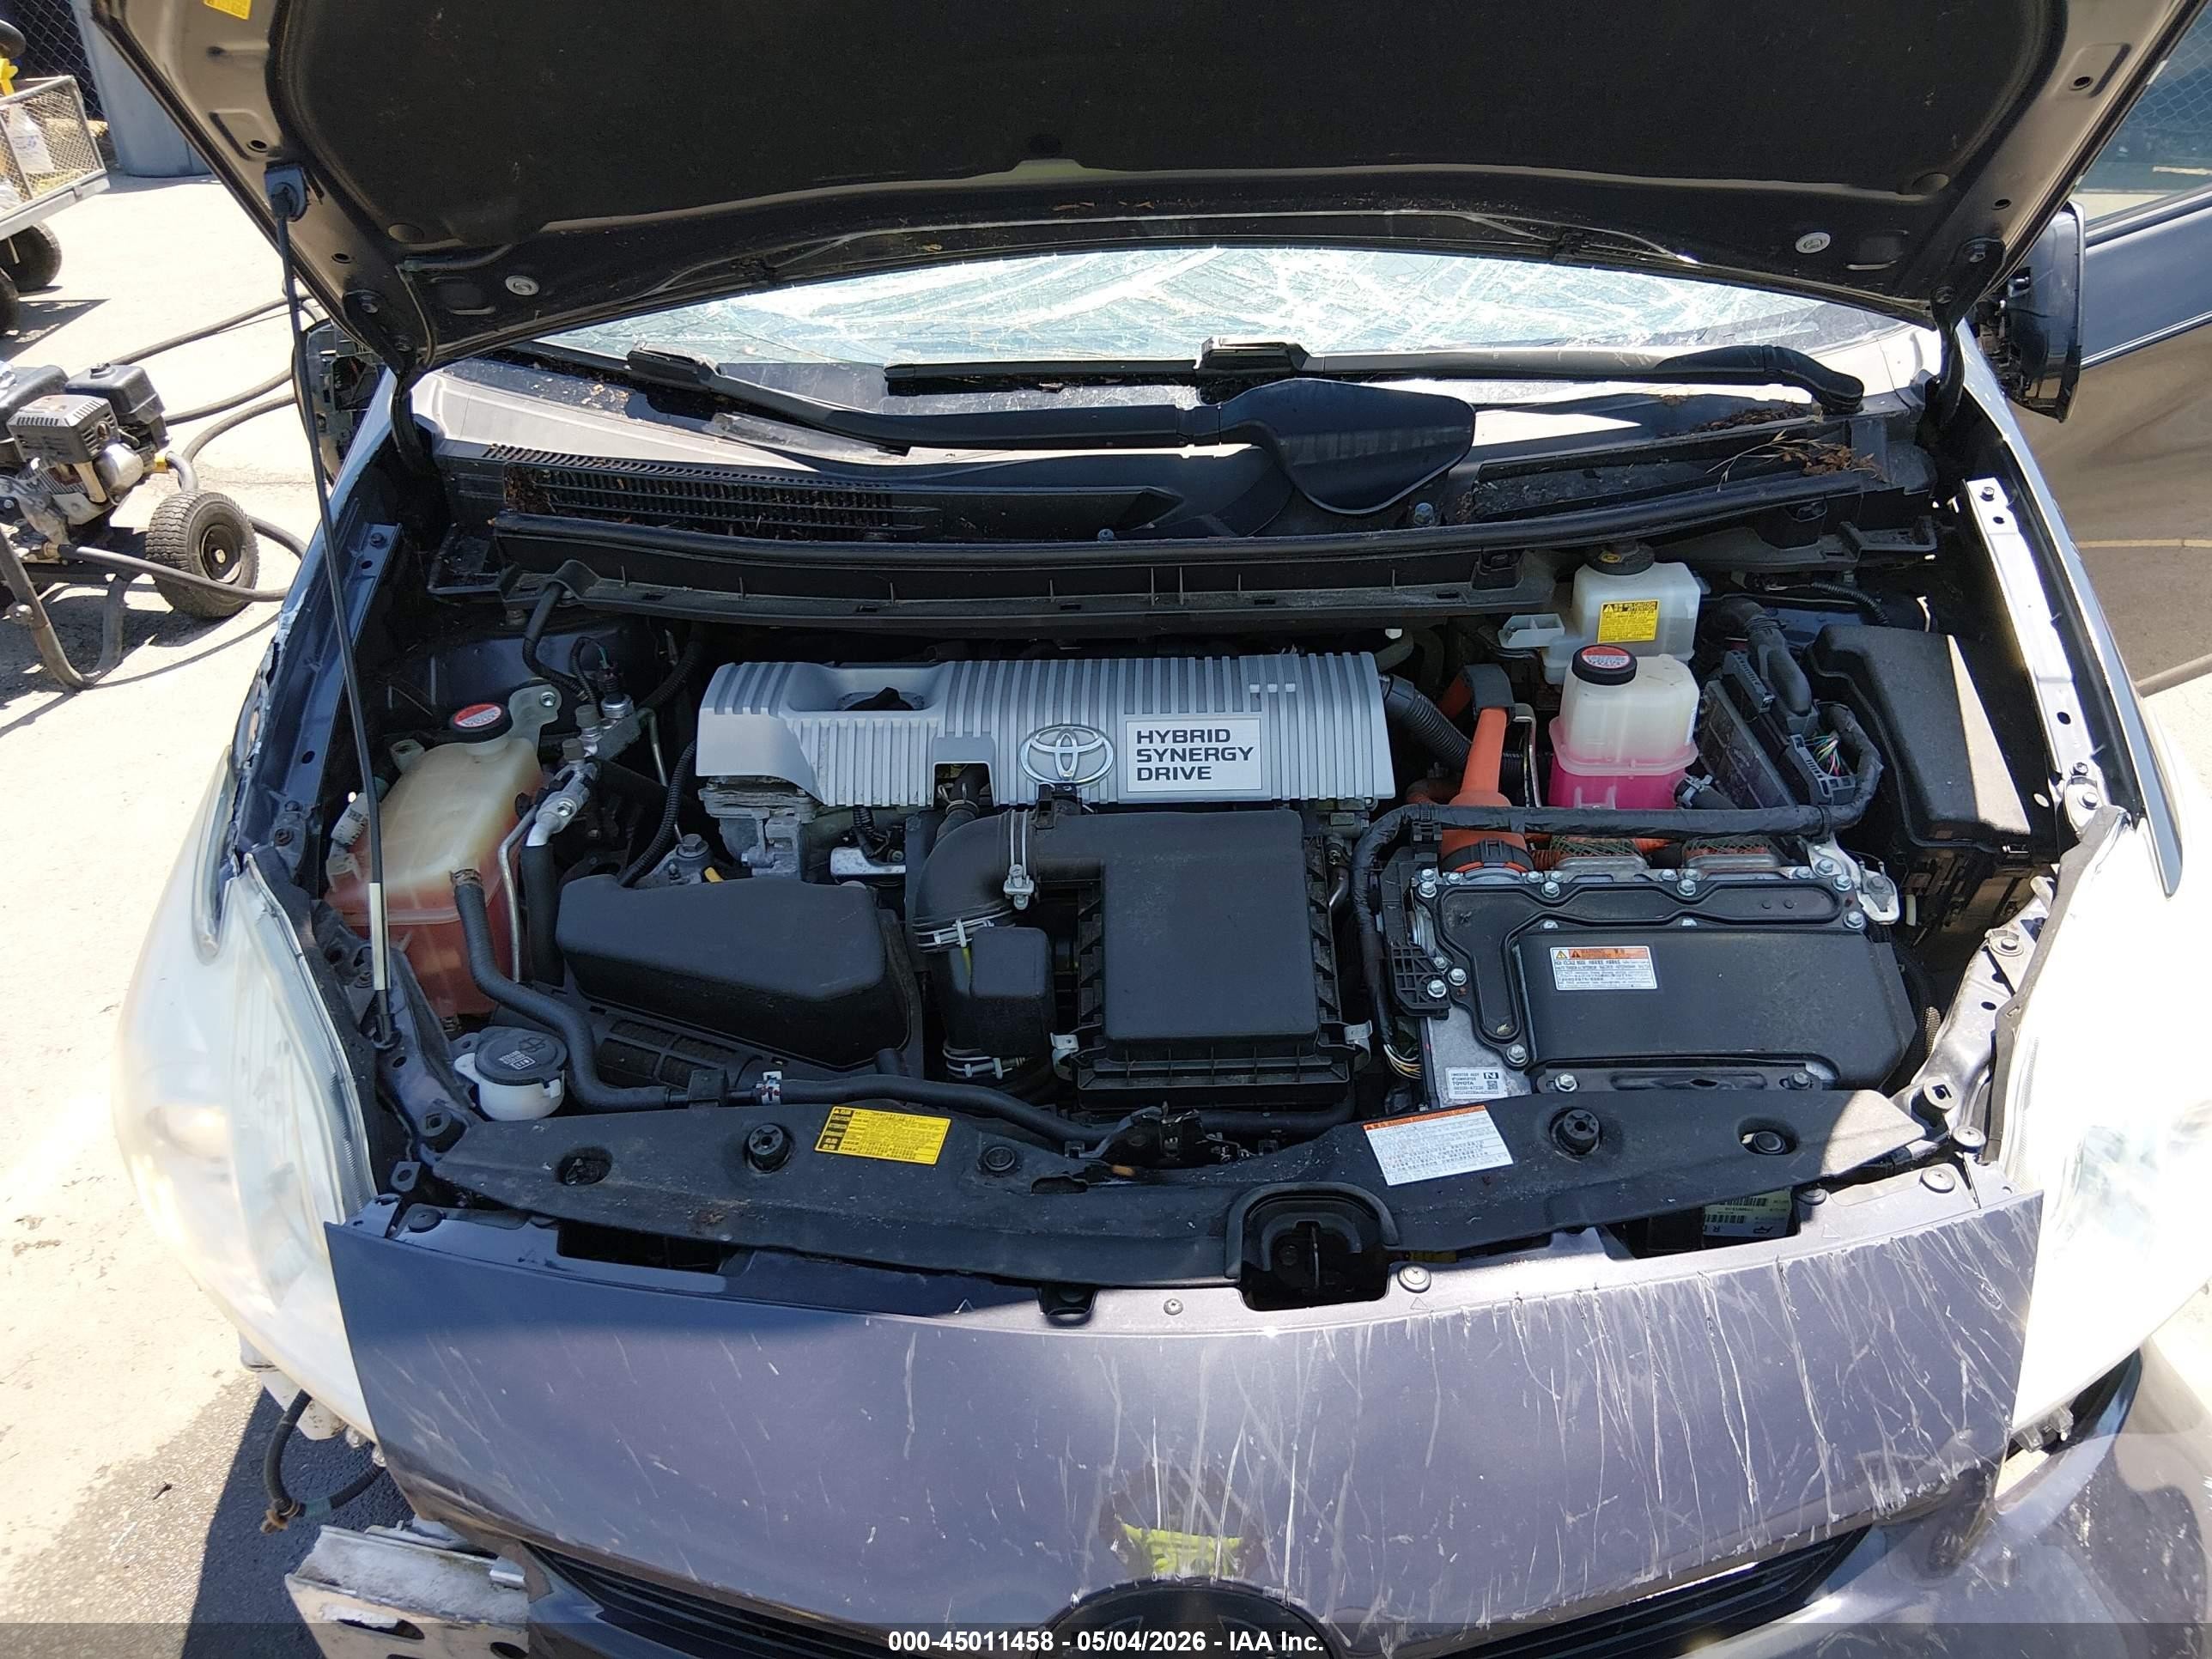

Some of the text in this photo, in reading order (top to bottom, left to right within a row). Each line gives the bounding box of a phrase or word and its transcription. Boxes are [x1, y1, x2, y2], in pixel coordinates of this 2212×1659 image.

[1137, 728, 1231, 744] HYBRID
[1136, 746, 1254, 763] SYNERGY
[1137, 766, 1212, 781] DRIVE
